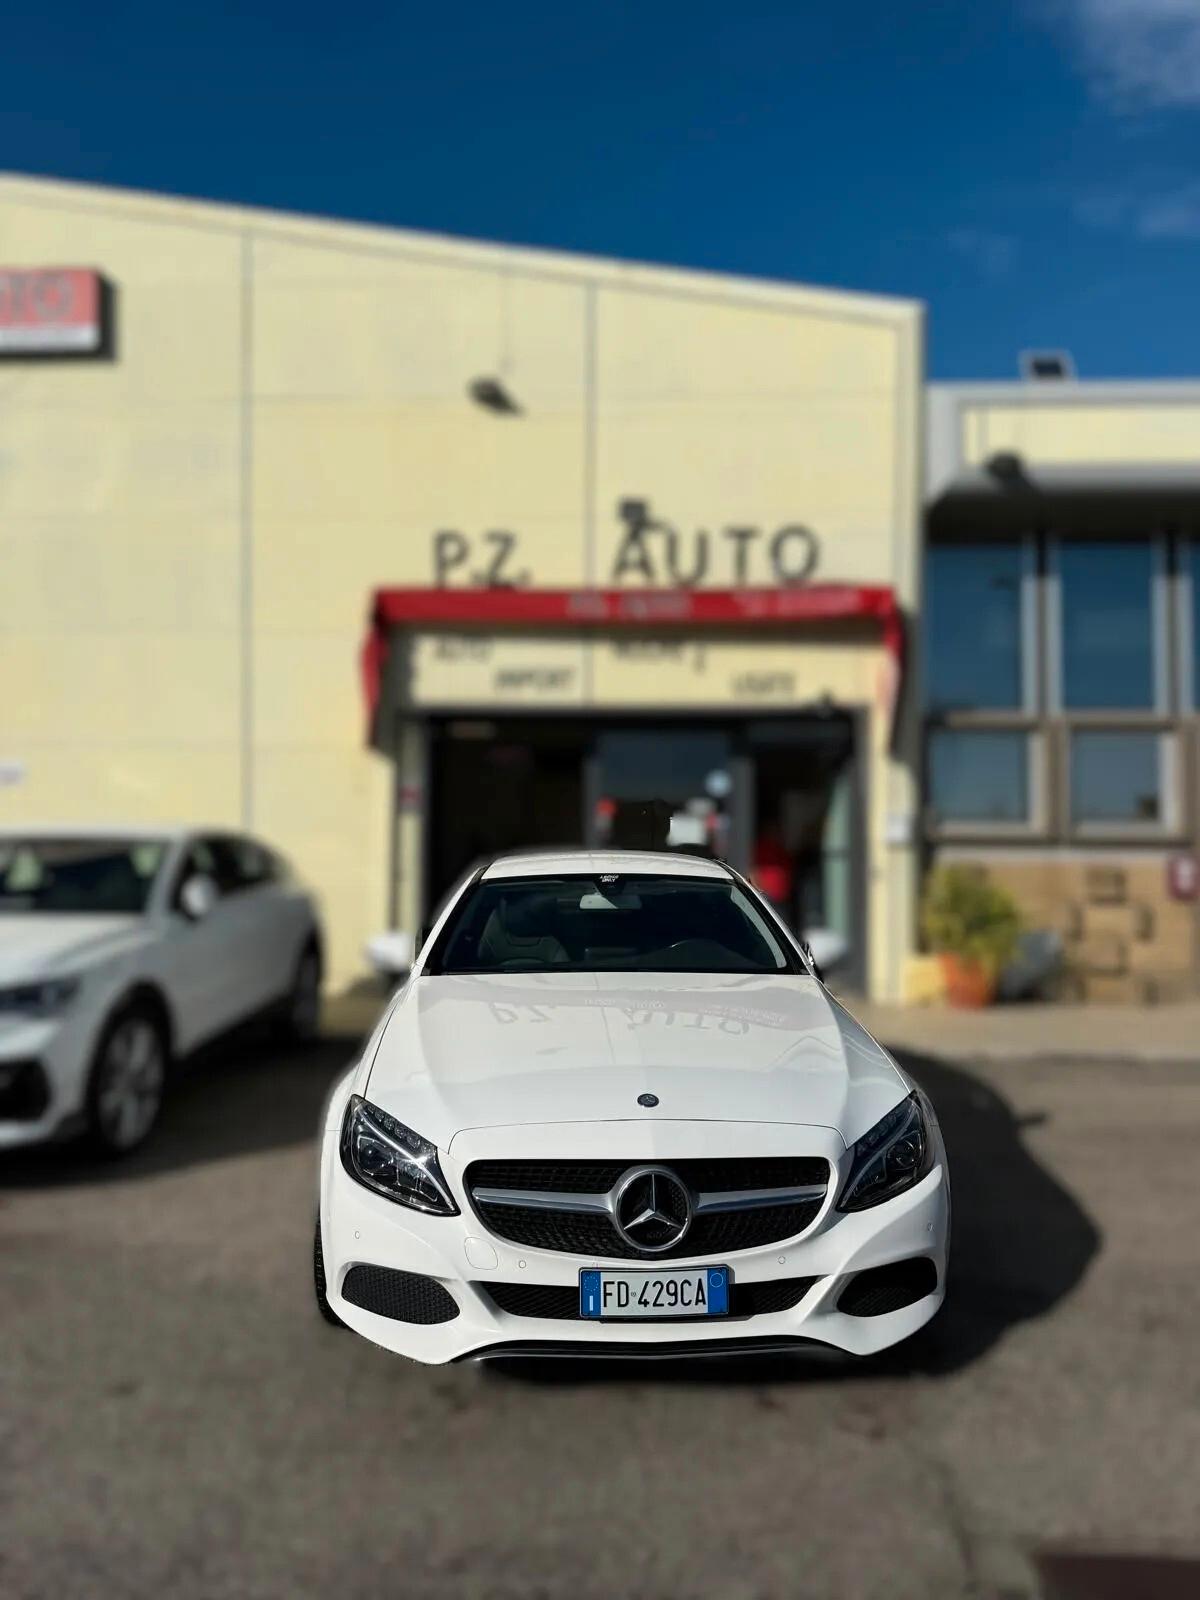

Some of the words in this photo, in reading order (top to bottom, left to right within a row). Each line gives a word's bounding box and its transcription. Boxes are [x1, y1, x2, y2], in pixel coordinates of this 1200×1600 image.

[611, 524, 820, 588] AUTO
[603, 1281, 630, 1308] FD
[638, 1278, 707, 1308] 429CA
